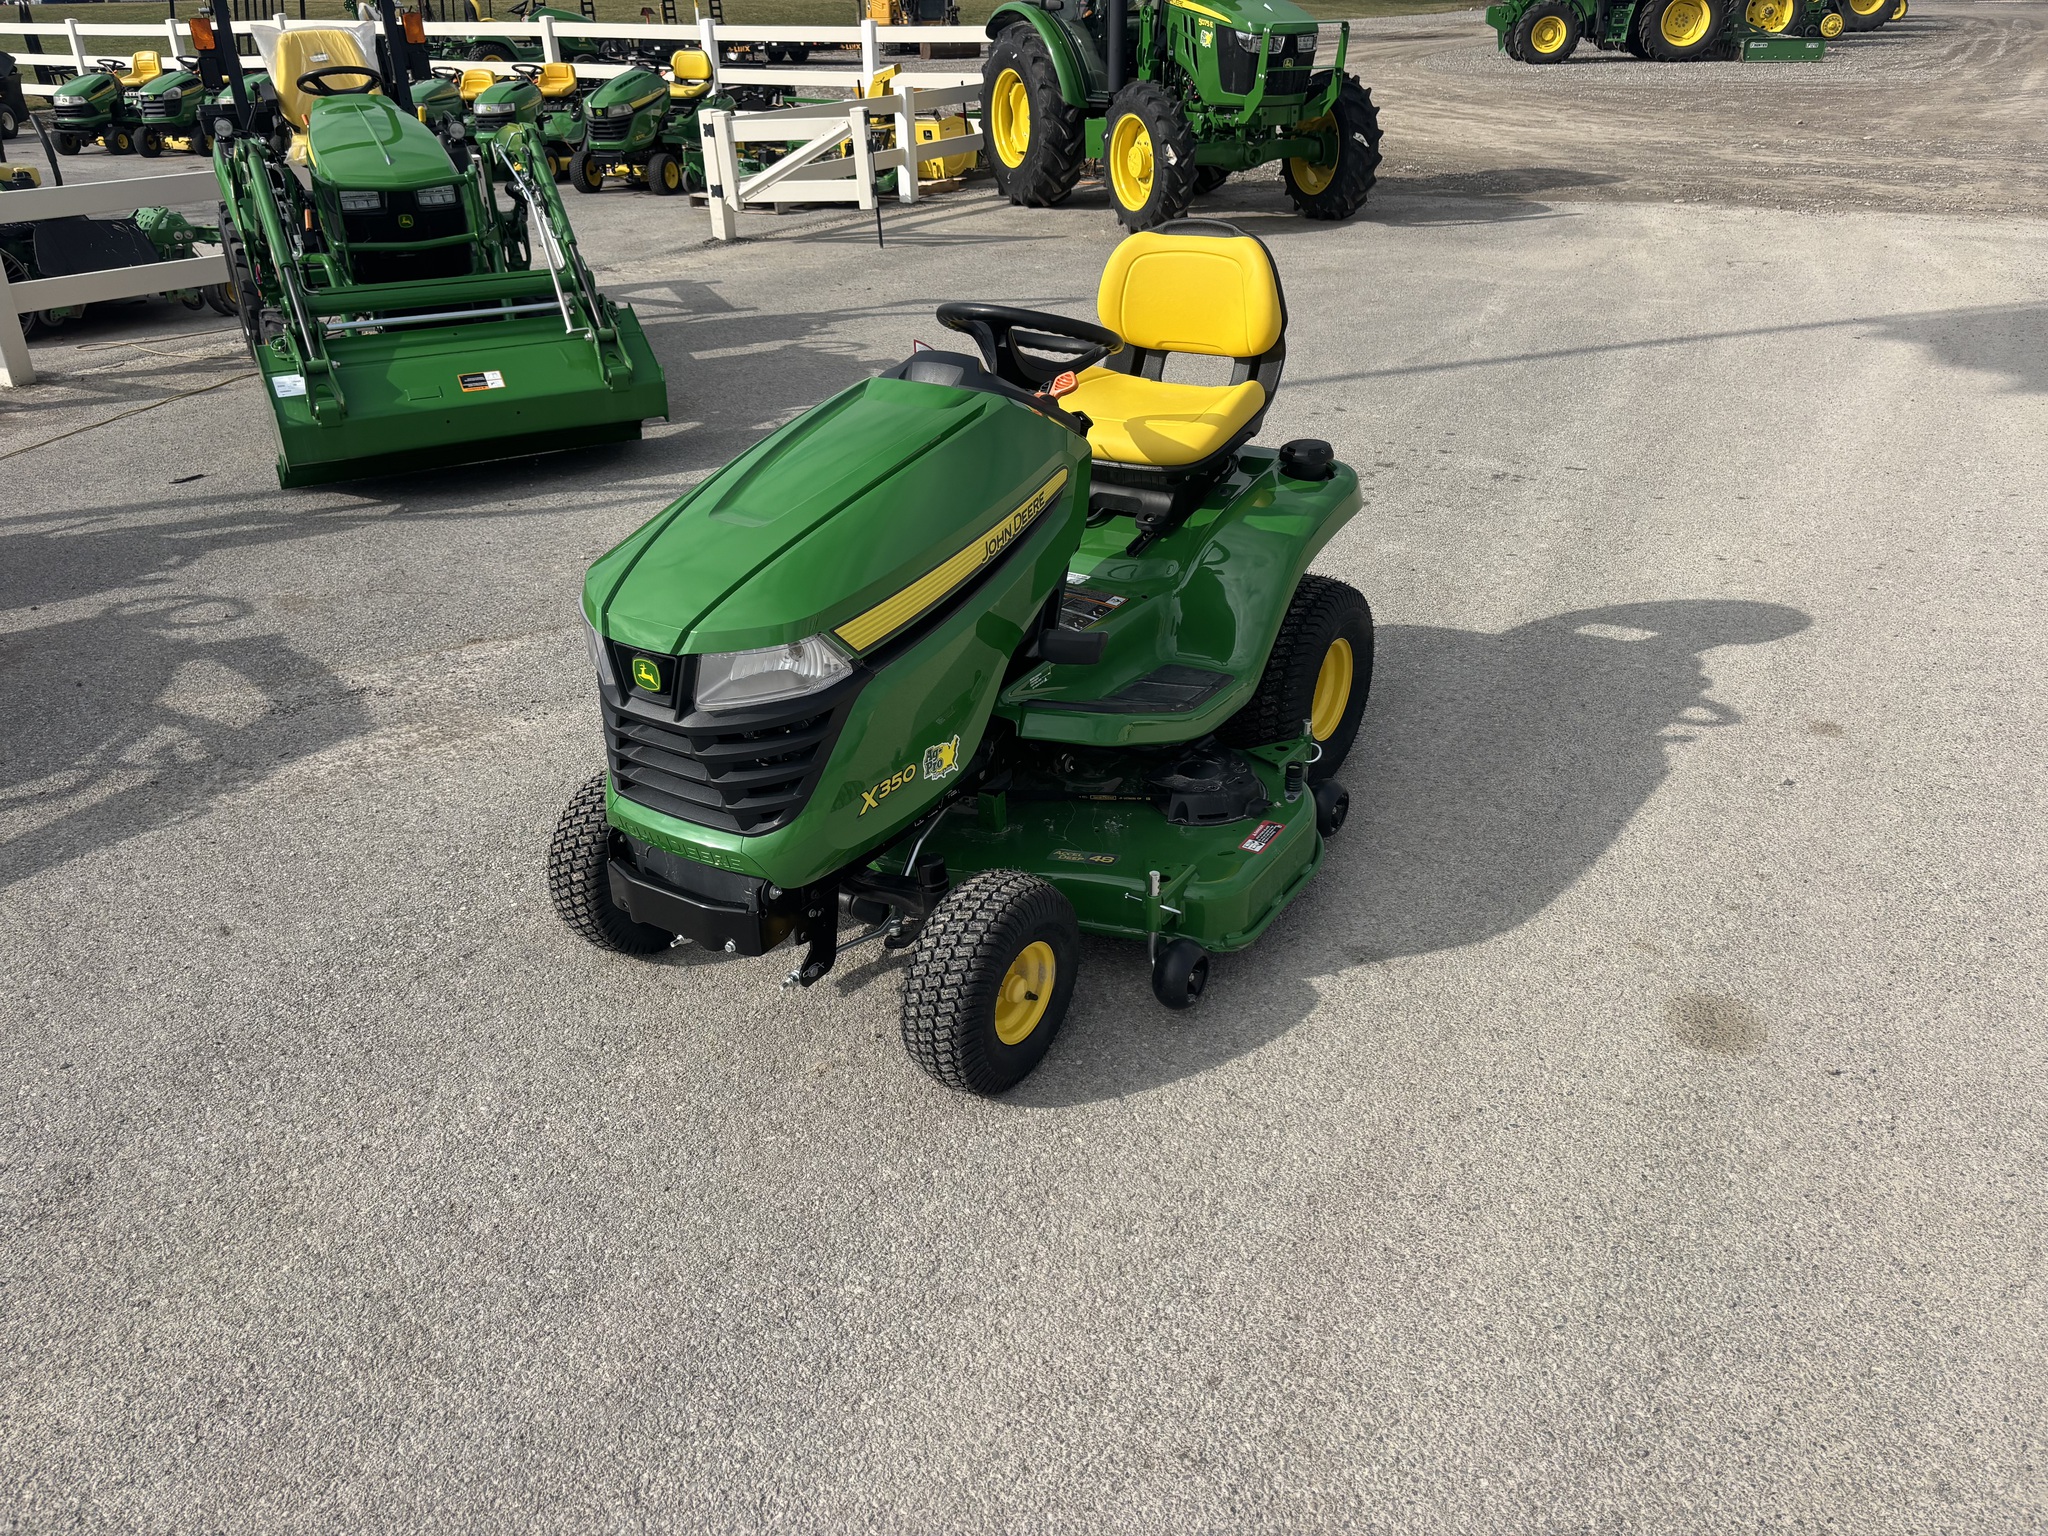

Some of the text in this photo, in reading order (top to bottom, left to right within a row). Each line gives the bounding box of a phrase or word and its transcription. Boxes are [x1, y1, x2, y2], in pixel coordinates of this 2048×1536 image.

[982, 490, 1045, 563] JOHN DEERE
[857, 763, 916, 817] X350
[665, 834, 745, 872] DEERE
[1089, 855, 1116, 863] 48
